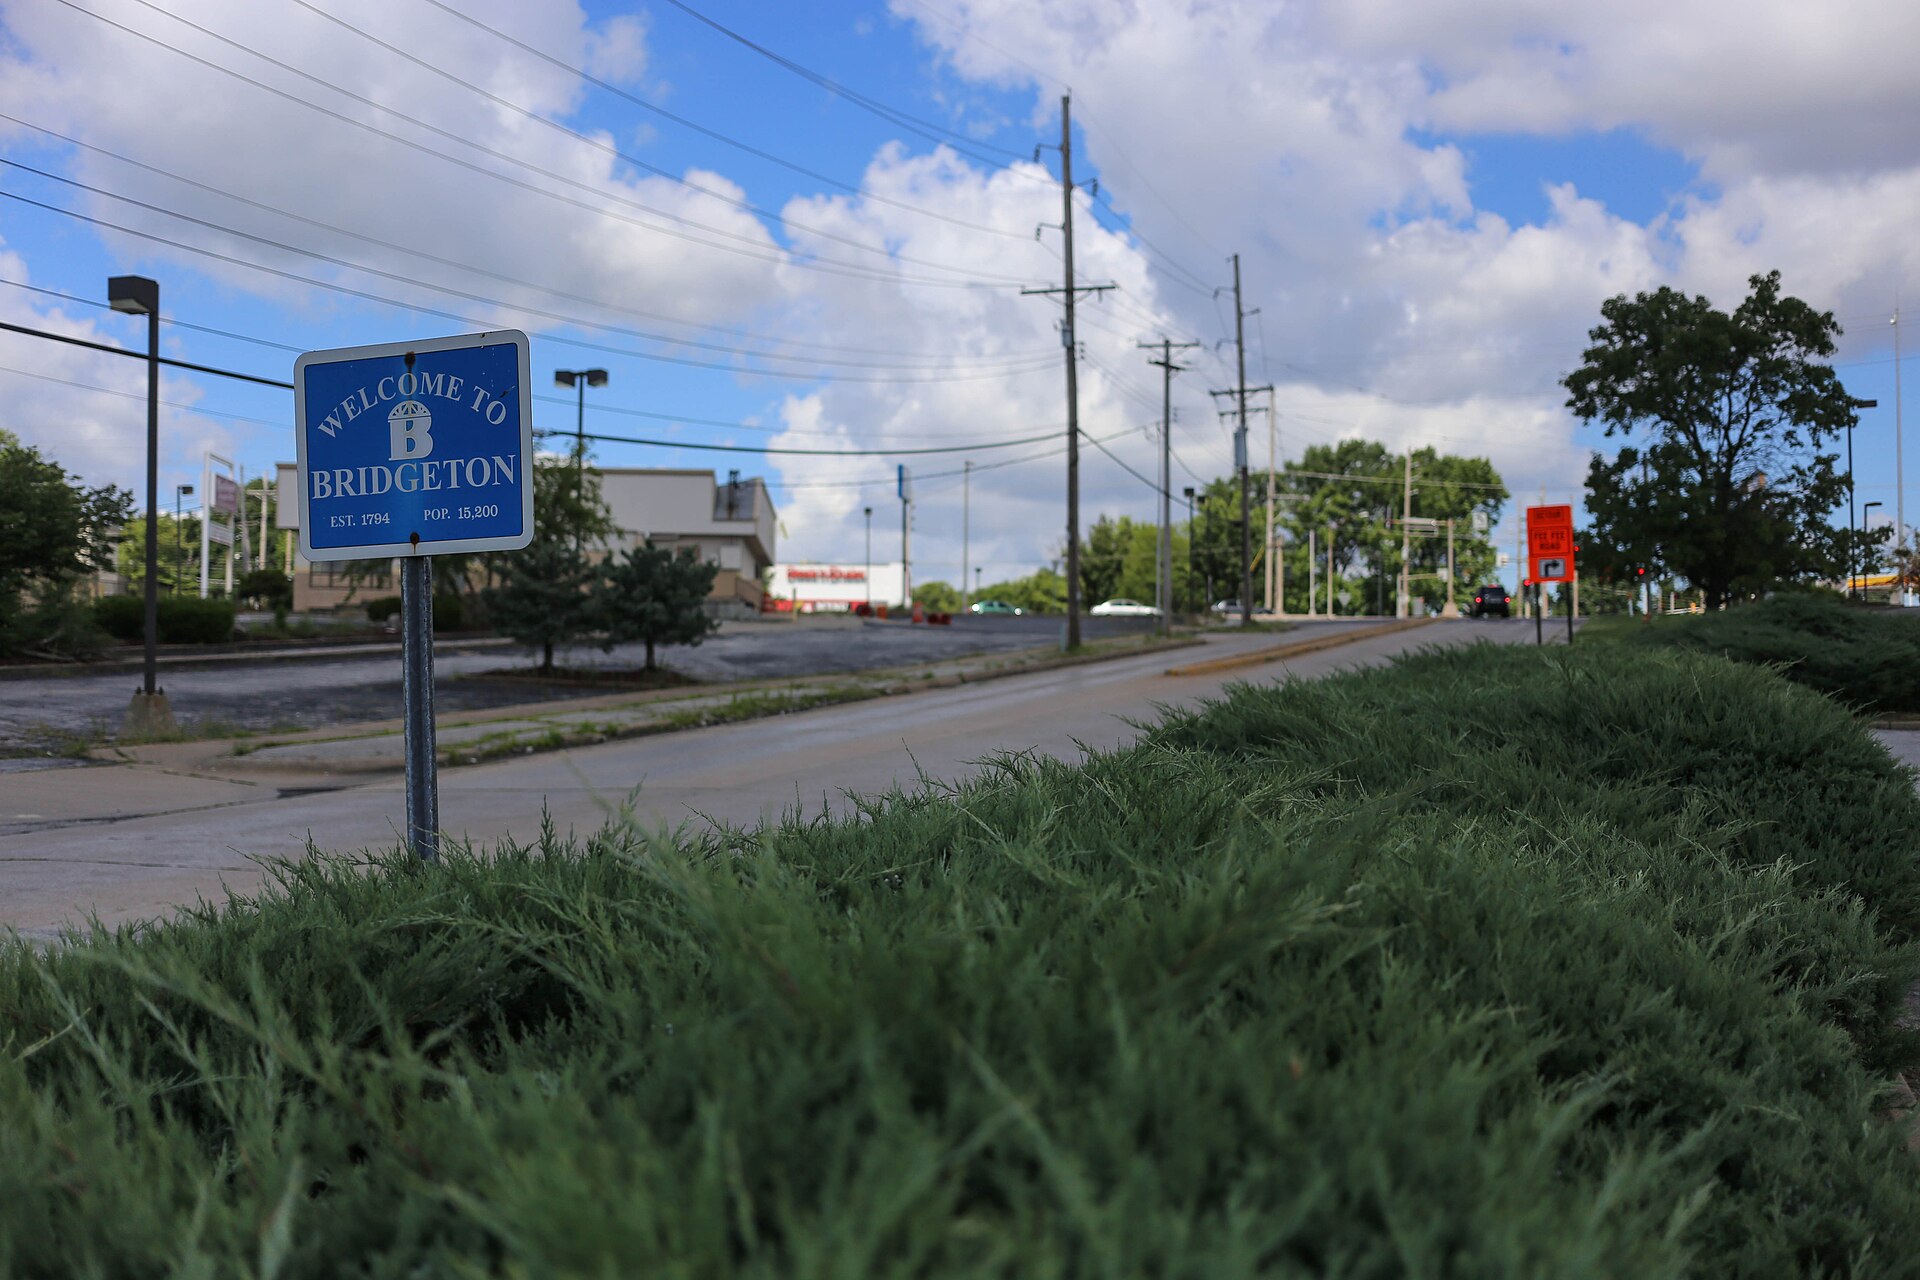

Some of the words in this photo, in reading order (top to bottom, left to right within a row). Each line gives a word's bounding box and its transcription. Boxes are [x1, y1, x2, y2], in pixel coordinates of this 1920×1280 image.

[318, 372, 464, 438] WELCOME
[471, 386, 506, 425] TO
[312, 455, 515, 499] BRIDGETON
[330, 515, 355, 528] EST.
[361, 513, 390, 526] 1794
[424, 508, 450, 521] POP.
[458, 505, 498, 520] 15,200
